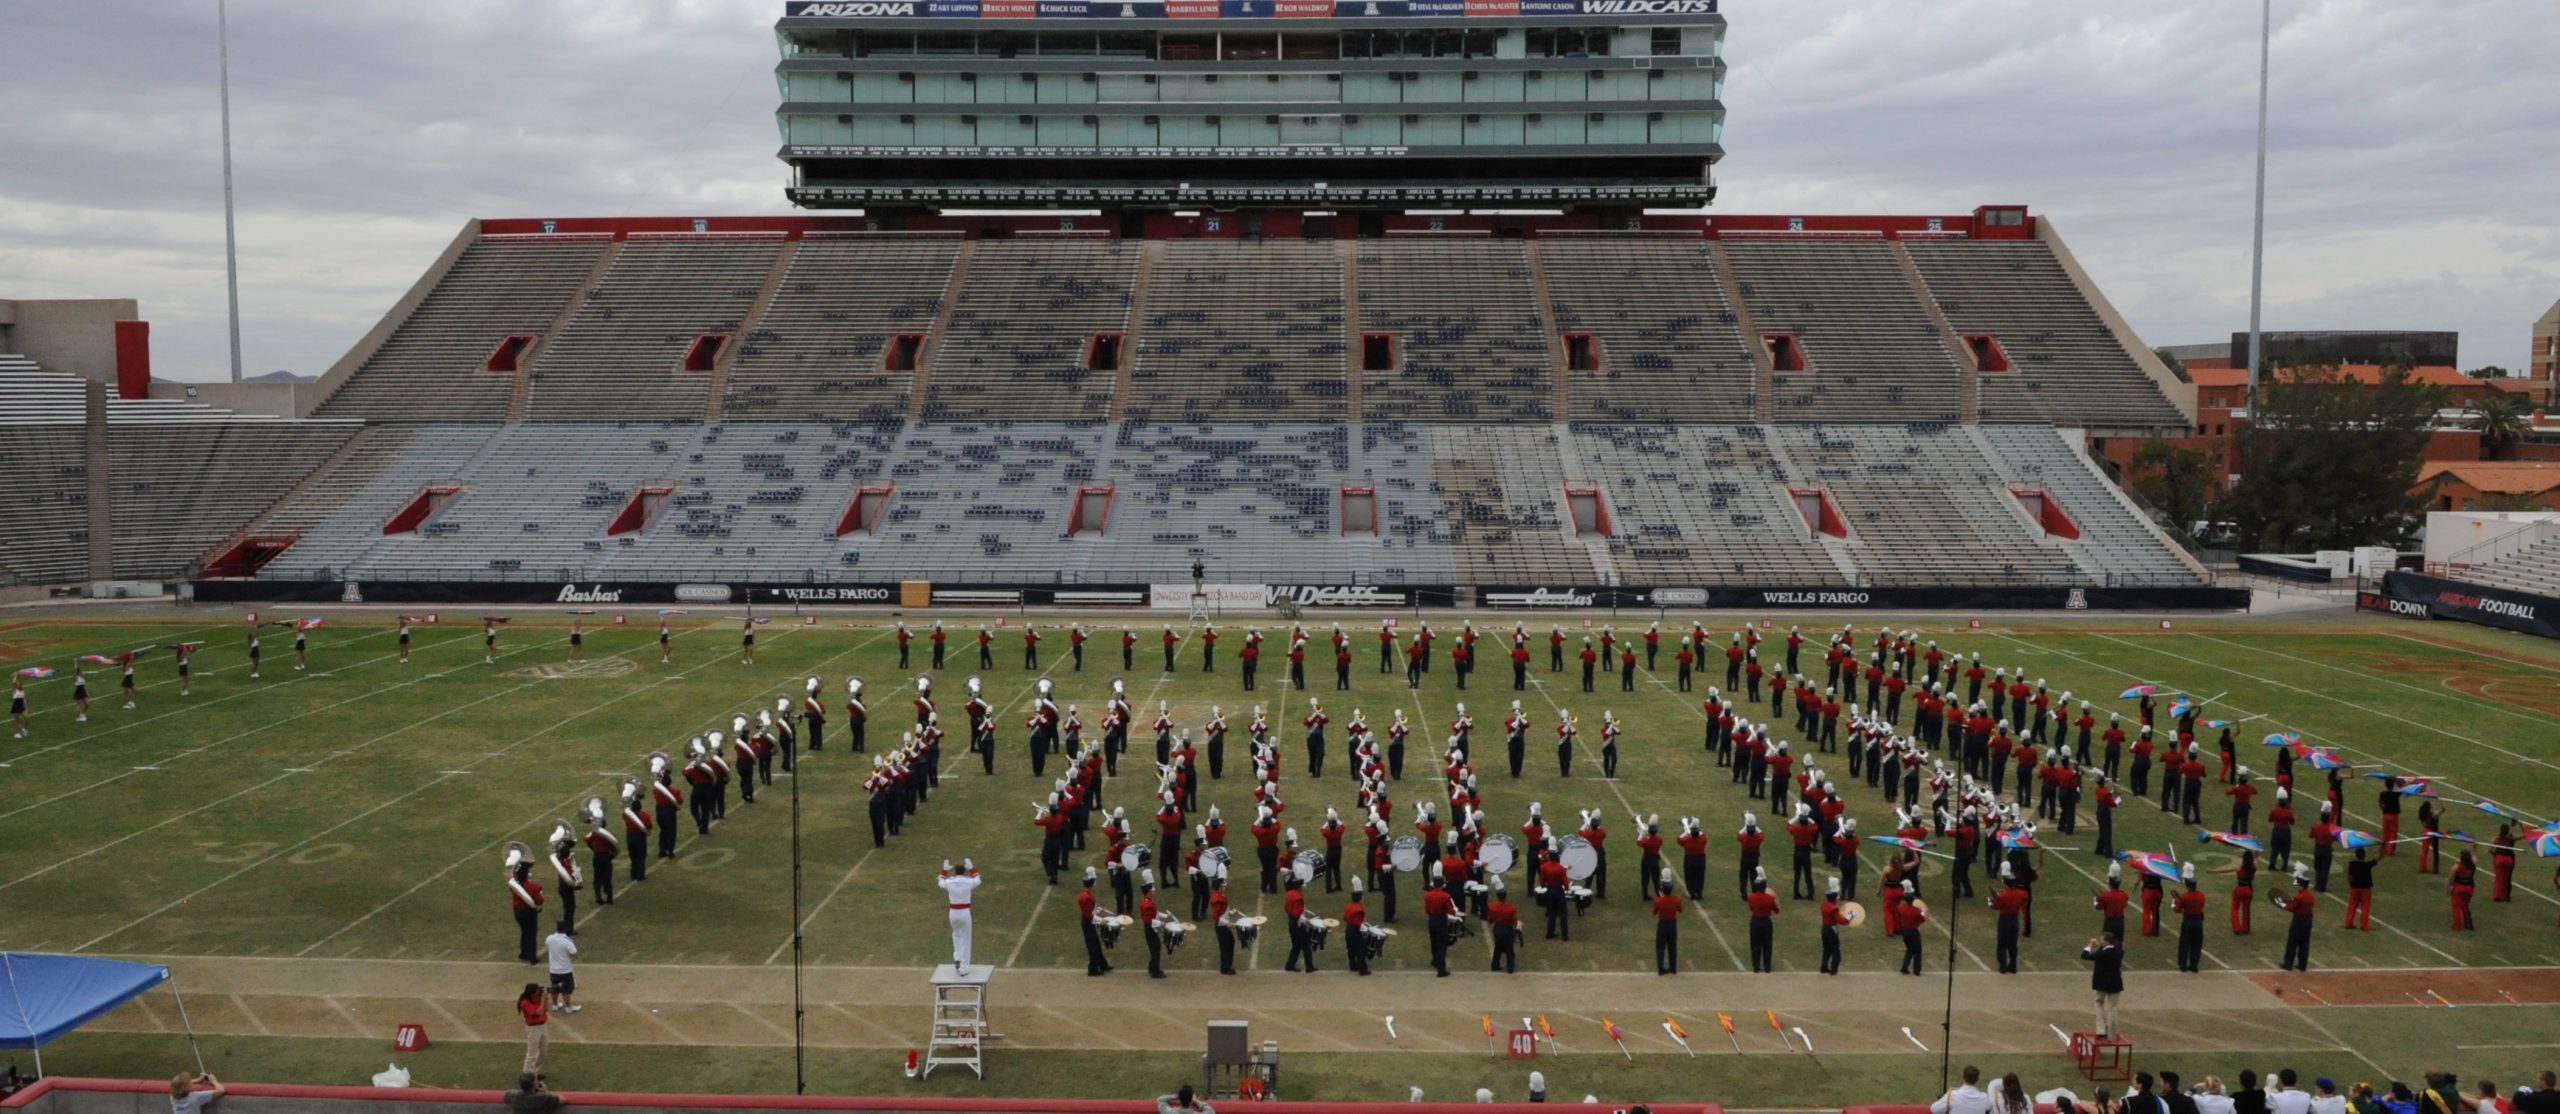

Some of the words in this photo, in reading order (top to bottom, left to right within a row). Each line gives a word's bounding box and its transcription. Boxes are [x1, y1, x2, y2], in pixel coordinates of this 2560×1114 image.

[798, 3, 915, 16] ARIZONA
[1046, 4, 1068, 13] CHUCK
[1200, 5, 1219, 13] LEWIS
[1298, 4, 1329, 12] WALDROP
[1552, 2, 1574, 10] CASON
[1582, 0, 1709, 13] WILDCATS
[543, 225, 554, 234] 17
[694, 223, 706, 233] 18
[866, 222, 878, 231] 19
[1059, 222, 1074, 230] 20
[1207, 221, 1219, 231] 21
[1430, 221, 1443, 230] 22
[1627, 221, 1641, 230] 23
[1789, 223, 1803, 231] 24
[1928, 222, 1942, 232] 25
[187, 387, 198, 396] 16
[556, 584, 623, 602] Bashas'
[784, 588, 837, 599] WELLS
[840, 588, 889, 599] FARGO
[1153, 591, 1190, 601] UNIVERSITY
[1230, 591, 1249, 601] BAND
[1250, 591, 1263, 601] DAY
[1763, 592, 1817, 604] WELLS
[1818, 592, 1869, 604] FARGO
[397, 1027, 416, 1048] 40
[1513, 1034, 1532, 1054] 40
